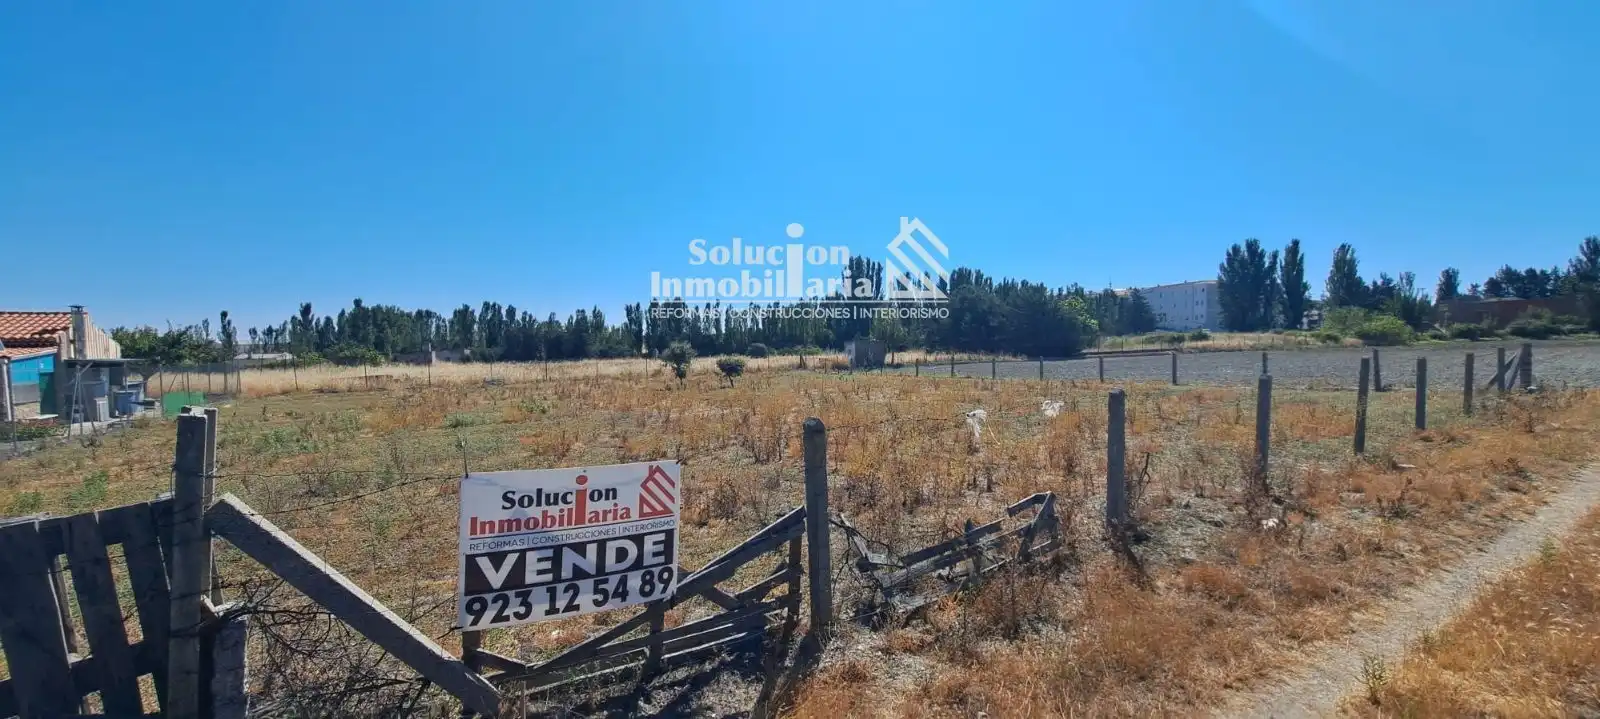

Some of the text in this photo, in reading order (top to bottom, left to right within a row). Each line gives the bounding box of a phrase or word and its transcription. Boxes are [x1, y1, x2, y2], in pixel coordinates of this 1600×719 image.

[501, 475, 617, 510] Solucion
[469, 502, 631, 536] Inmobiliaria
[469, 519, 675, 551] REFORMAS CONSTRUCCIONES INTERIORISMO
[475, 533, 665, 590] VENDE
[465, 565, 674, 627] 923 12 54 89
